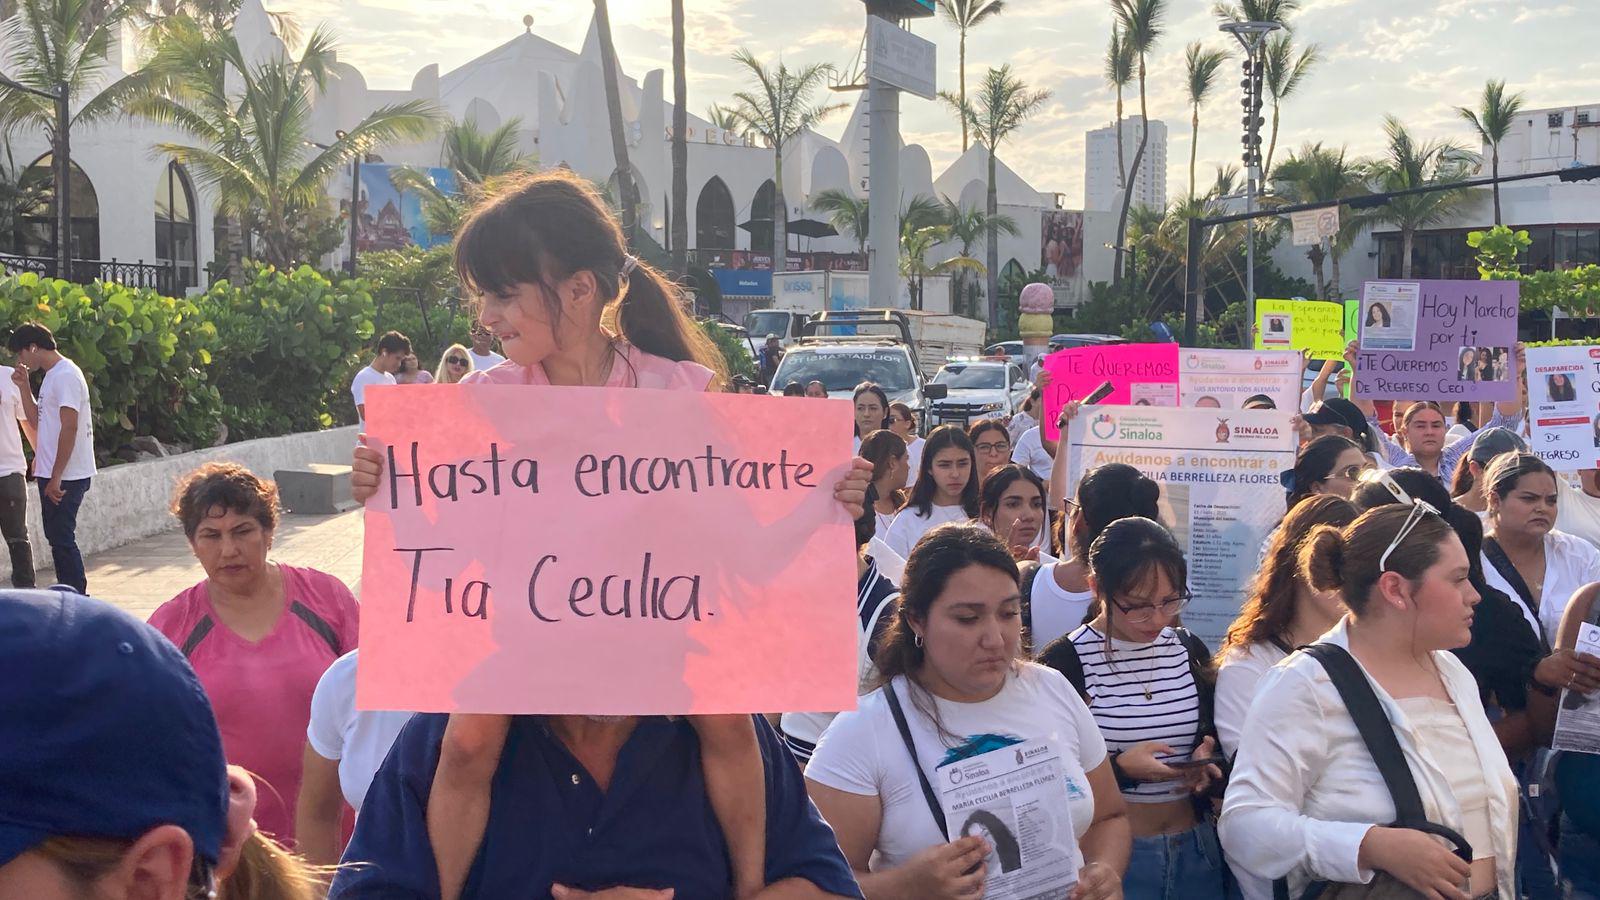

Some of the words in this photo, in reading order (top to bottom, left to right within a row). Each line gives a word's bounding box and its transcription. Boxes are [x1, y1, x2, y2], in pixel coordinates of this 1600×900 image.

[1422, 294, 1457, 328] Hoy
[1463, 294, 1516, 319] Marcho
[1429, 331, 1454, 350] por
[1460, 325, 1478, 347] ti
[1058, 354, 1082, 374] TE
[1092, 352, 1173, 376] QUEREMOS
[1381, 354, 1448, 372] QUEREMOS
[1535, 365, 1584, 373] DESAPARECIDA
[1356, 380, 1371, 393] DE
[1374, 378, 1429, 393] REGRESO
[1437, 379, 1465, 393] CECI
[1119, 428, 1162, 441] Sinaloa
[1234, 426, 1279, 435] SINALOA
[1177, 456, 1186, 466] a
[1190, 455, 1265, 469] encontrar
[1268, 459, 1278, 469] a
[388, 442, 539, 509] Hasta
[575, 446, 817, 496] encontrarte
[1170, 472, 1236, 484] BERRELLEZA
[1240, 474, 1279, 484] FLORES
[964, 767, 990, 781] Sinaloa
